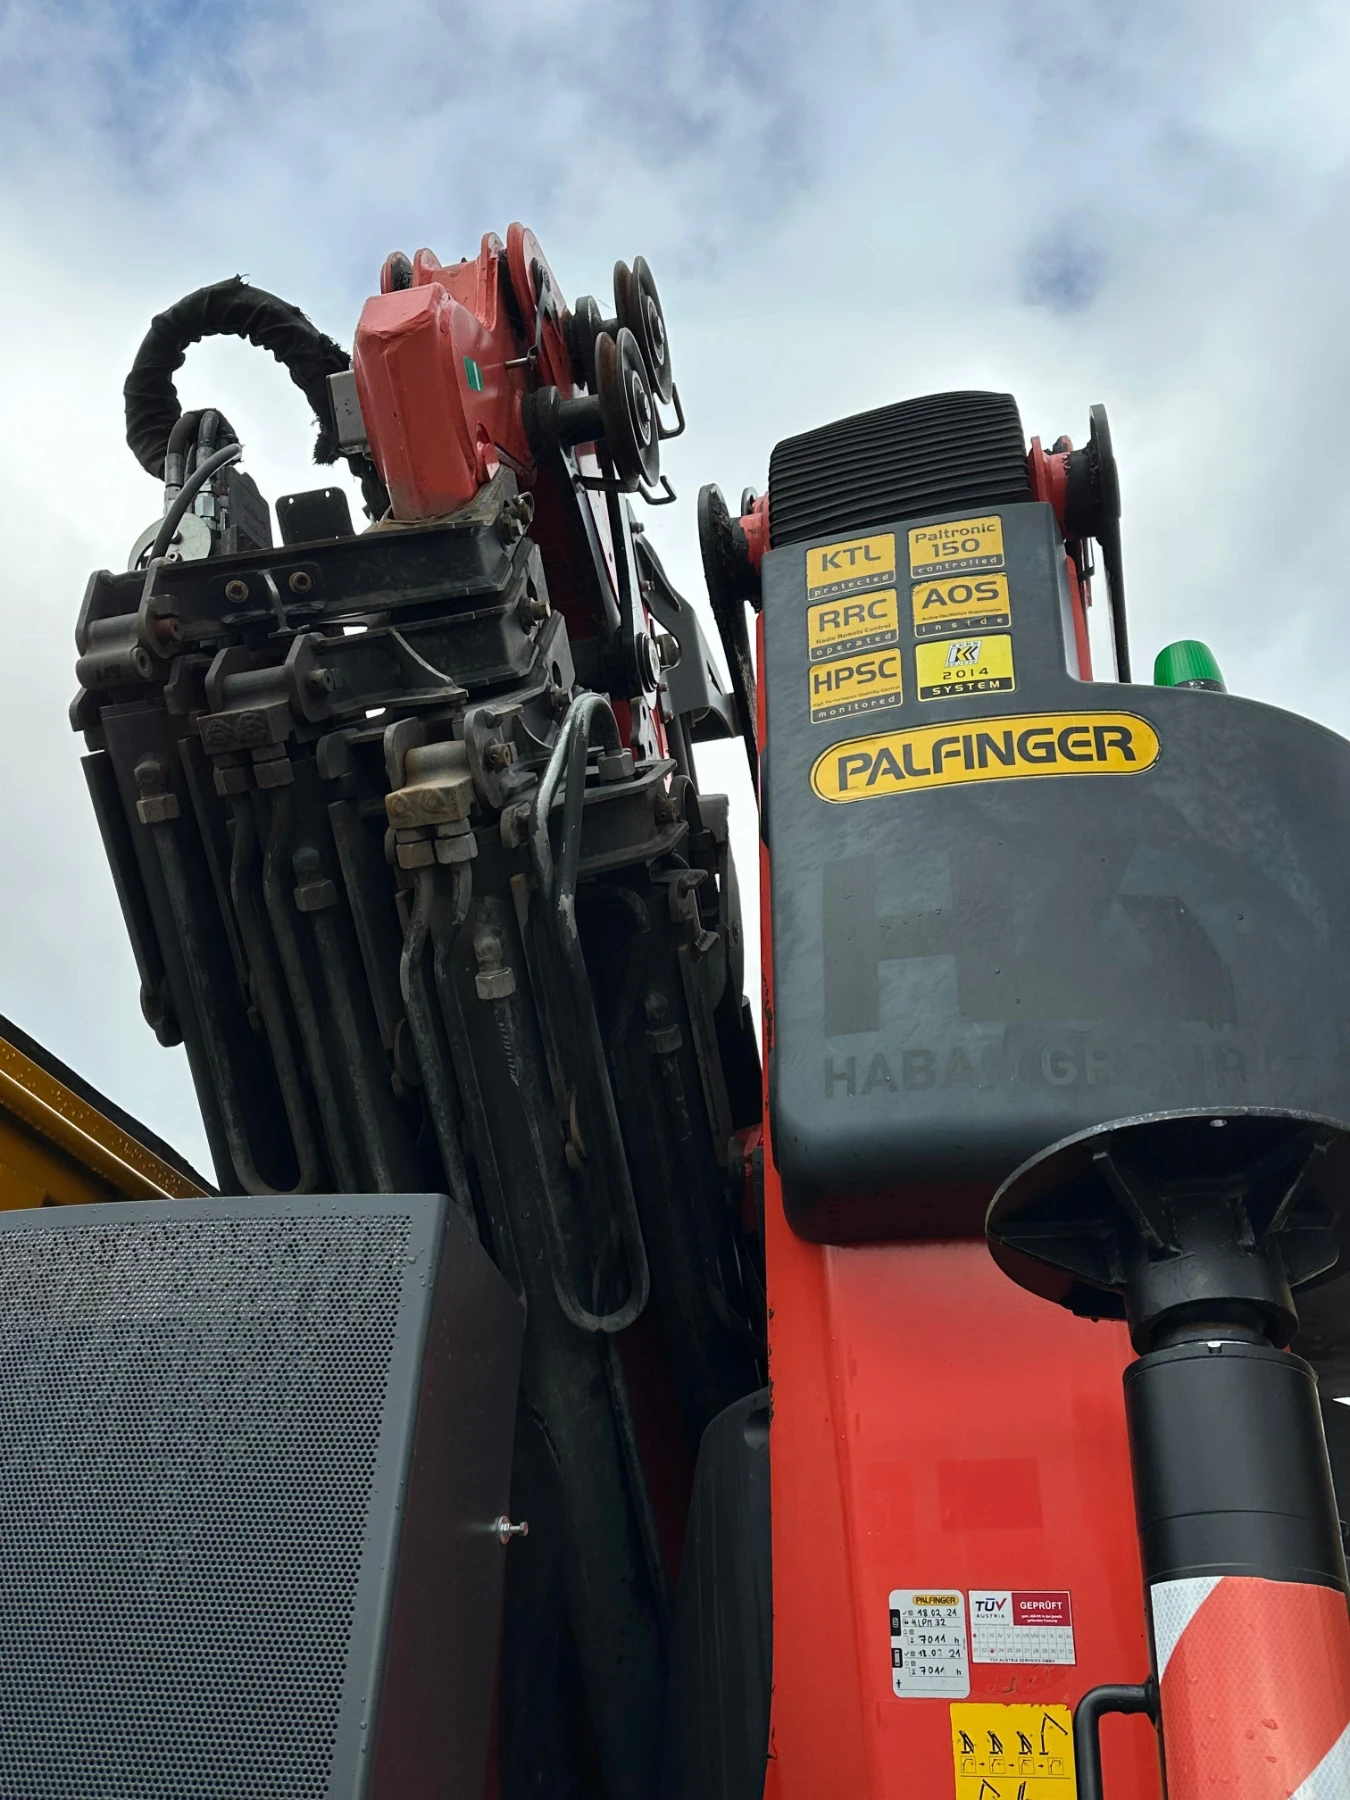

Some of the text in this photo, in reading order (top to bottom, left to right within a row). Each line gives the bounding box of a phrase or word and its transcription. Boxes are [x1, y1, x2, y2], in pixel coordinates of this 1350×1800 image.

[915, 523, 996, 543] Paltronic
[932, 538, 980, 557] 150
[822, 545, 881, 572] KTL
[918, 557, 997, 573] controlled
[814, 574, 889, 597] protected
[922, 581, 999, 609] AOS
[819, 598, 888, 632] RRC
[922, 617, 1003, 633] inside
[816, 623, 891, 644] Radio Remote Control
[816, 633, 892, 655] operated
[814, 657, 897, 694] HPSC
[943, 667, 989, 680] 2014
[932, 681, 1000, 695] SYSTEM
[818, 695, 895, 718] monitored
[838, 725, 1136, 791] PALFINGER
[915, 1596, 956, 1604] PALFINGER
[975, 1597, 1007, 1612] TÜV
[1020, 1600, 1062, 1610] GEPRÜFT
